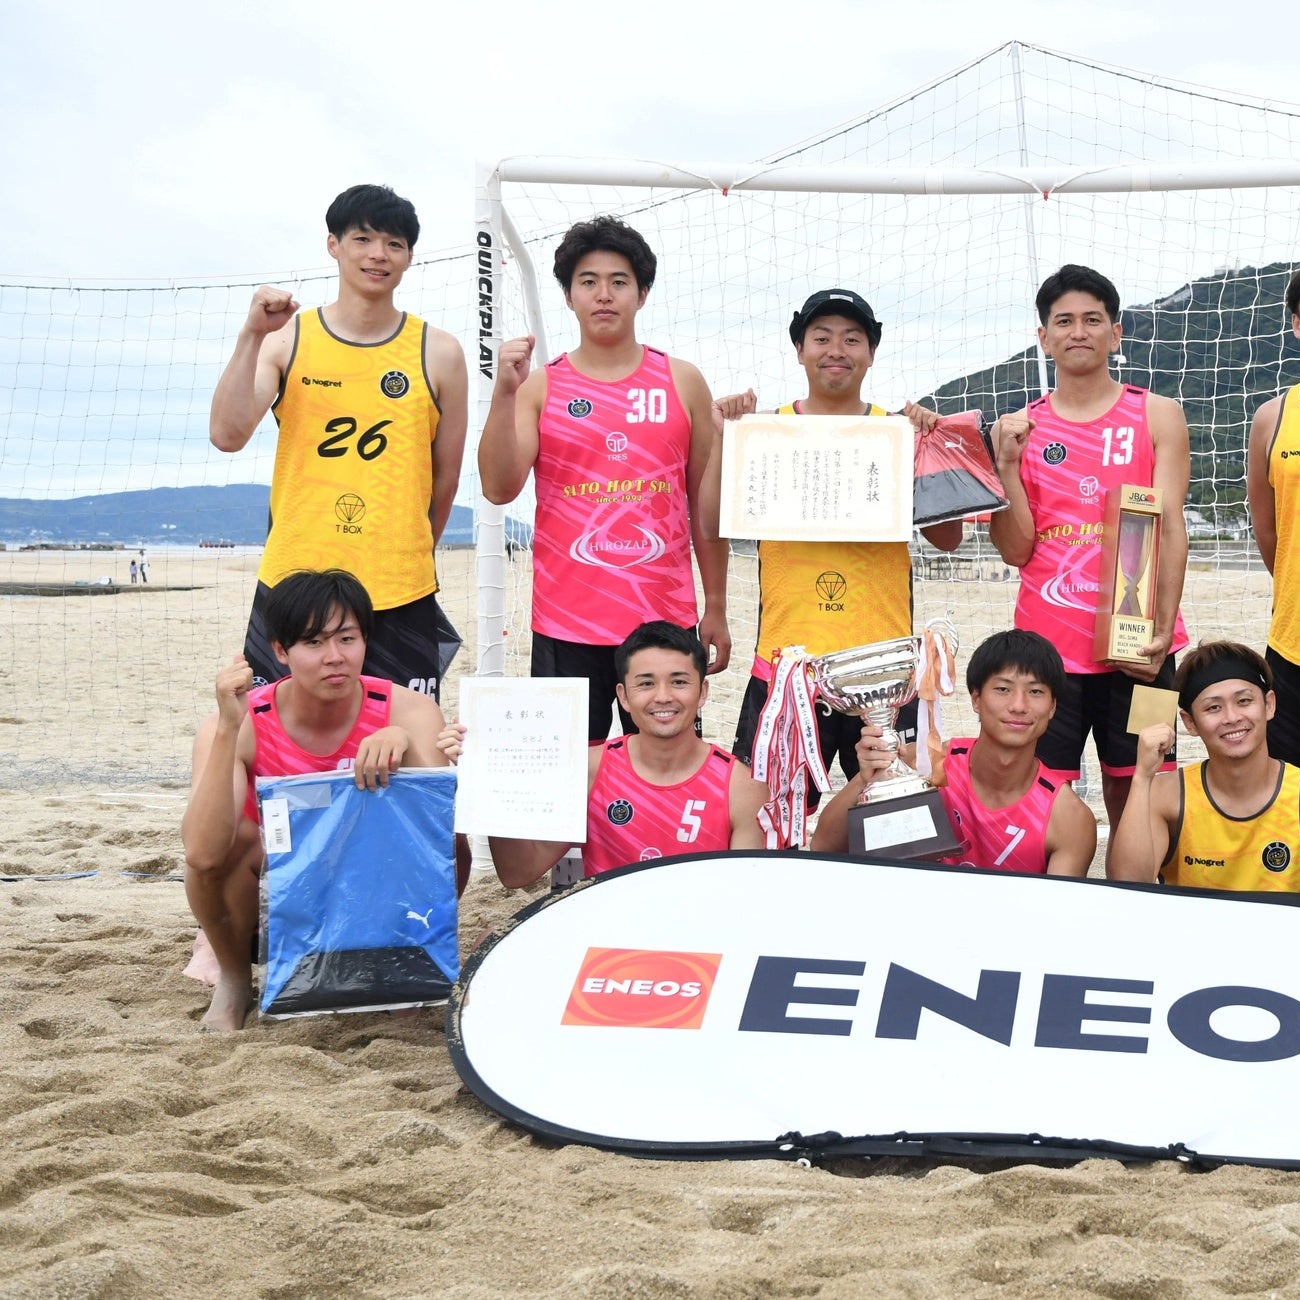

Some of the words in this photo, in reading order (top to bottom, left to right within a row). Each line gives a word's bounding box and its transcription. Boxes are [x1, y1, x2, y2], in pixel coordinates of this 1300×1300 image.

[477, 231, 493, 380] QUICKPLAY
[312, 379, 342, 387] Nogret
[626, 388, 667, 424] 30
[317, 417, 394, 461] 26
[1101, 426, 1134, 467] 13
[607, 454, 628, 462] TRES
[563, 482, 600, 498] SATO
[606, 479, 645, 493] HOT
[649, 480, 672, 494] SPA
[866, 462, 880, 502] 表彰状
[343, 525, 362, 534] BOX
[1037, 524, 1073, 543] SATO
[1079, 521, 1104, 535] HO
[590, 540, 648, 552] HIROZAP
[825, 603, 845, 611] BOX
[1119, 623, 1146, 633] WINNER
[676, 799, 706, 843] 5
[994, 824, 1026, 866] 7
[1194, 858, 1225, 867] Nogret
[582, 976, 701, 998] ENEOS
